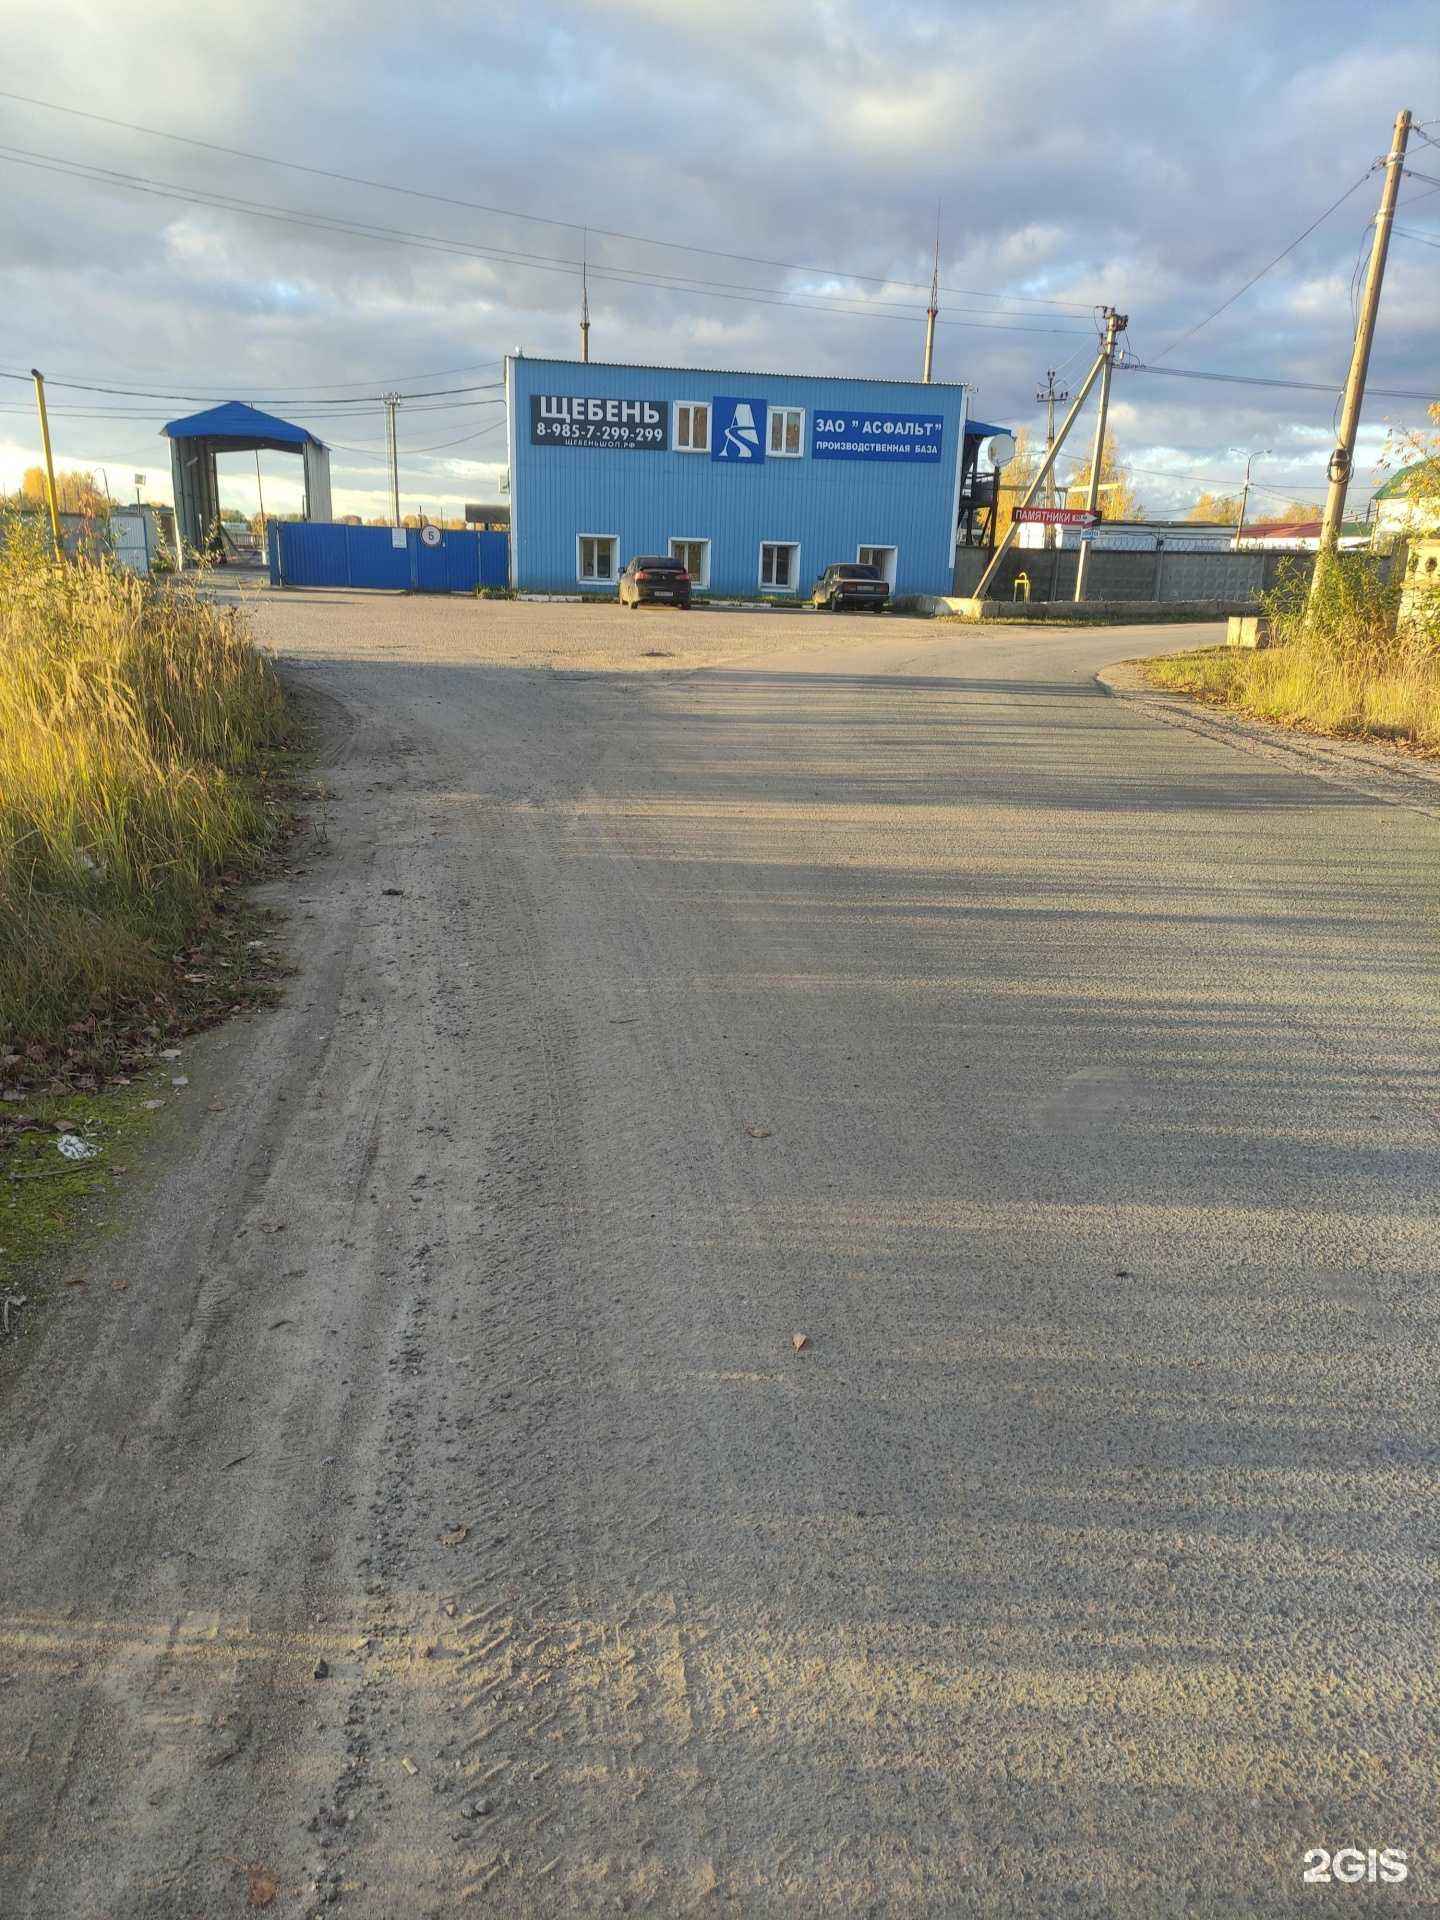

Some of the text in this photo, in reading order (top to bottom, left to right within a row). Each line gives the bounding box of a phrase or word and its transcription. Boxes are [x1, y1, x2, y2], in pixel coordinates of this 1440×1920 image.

[540, 396, 660, 424] ЩЕБЕНЬ
[536, 422, 663, 442] 8-985-7-299-299
[816, 418, 845, 433] ЗАО
[816, 440, 937, 454] ПРОИЗВОДСТВЕННАЯ БАЗА
[1015, 509, 1071, 523] ПАМЯТНИКИ
